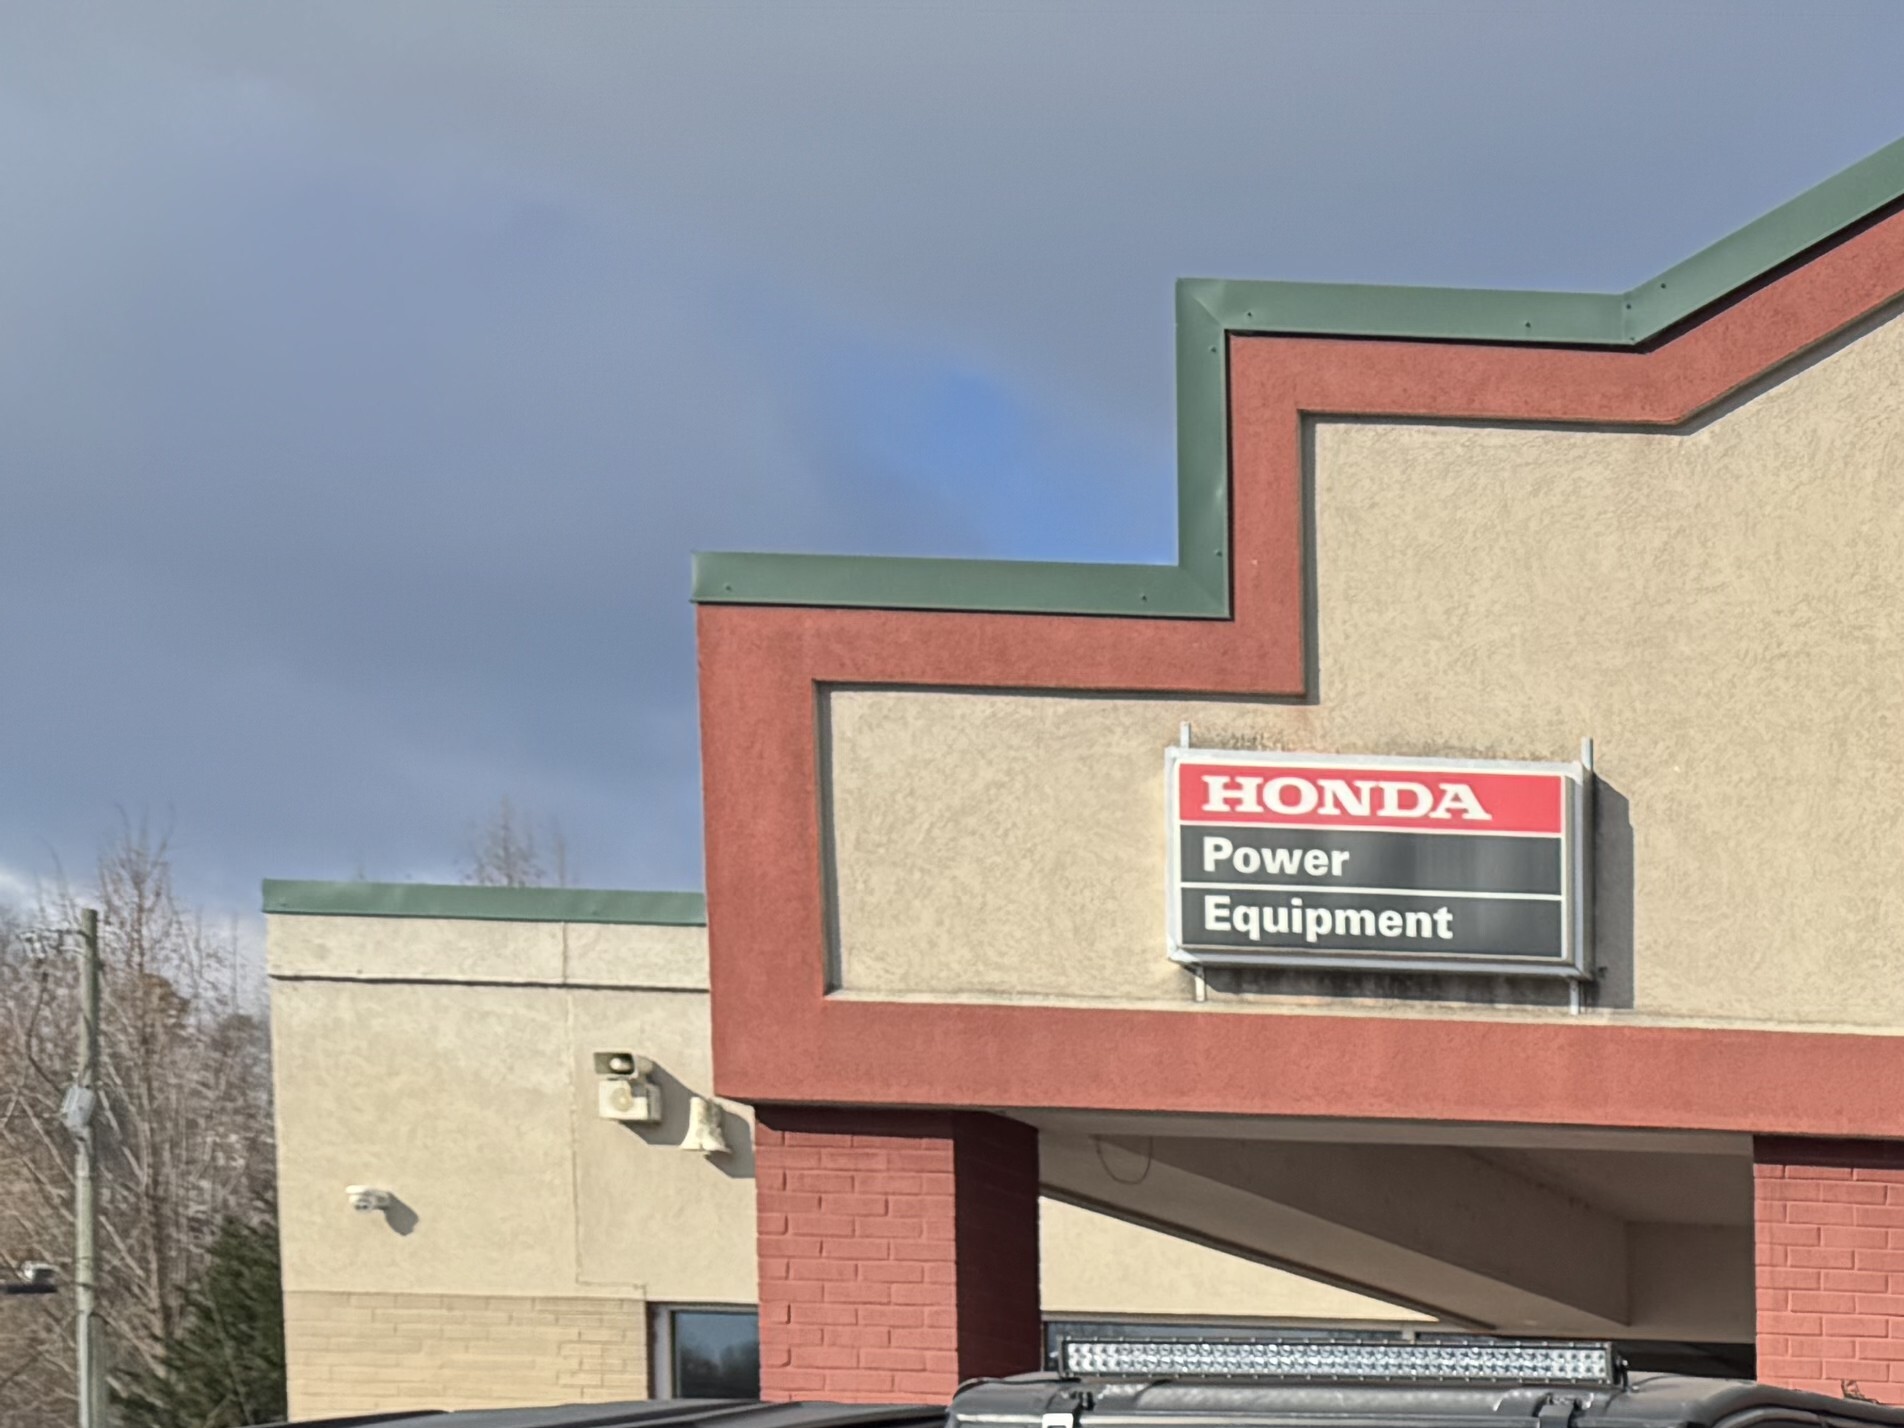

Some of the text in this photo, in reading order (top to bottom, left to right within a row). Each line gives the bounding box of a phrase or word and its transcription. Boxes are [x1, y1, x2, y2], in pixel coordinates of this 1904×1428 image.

[1201, 774, 1493, 822] HONDA
[1201, 836, 1350, 878] Power
[1203, 895, 1454, 944] Equipment
